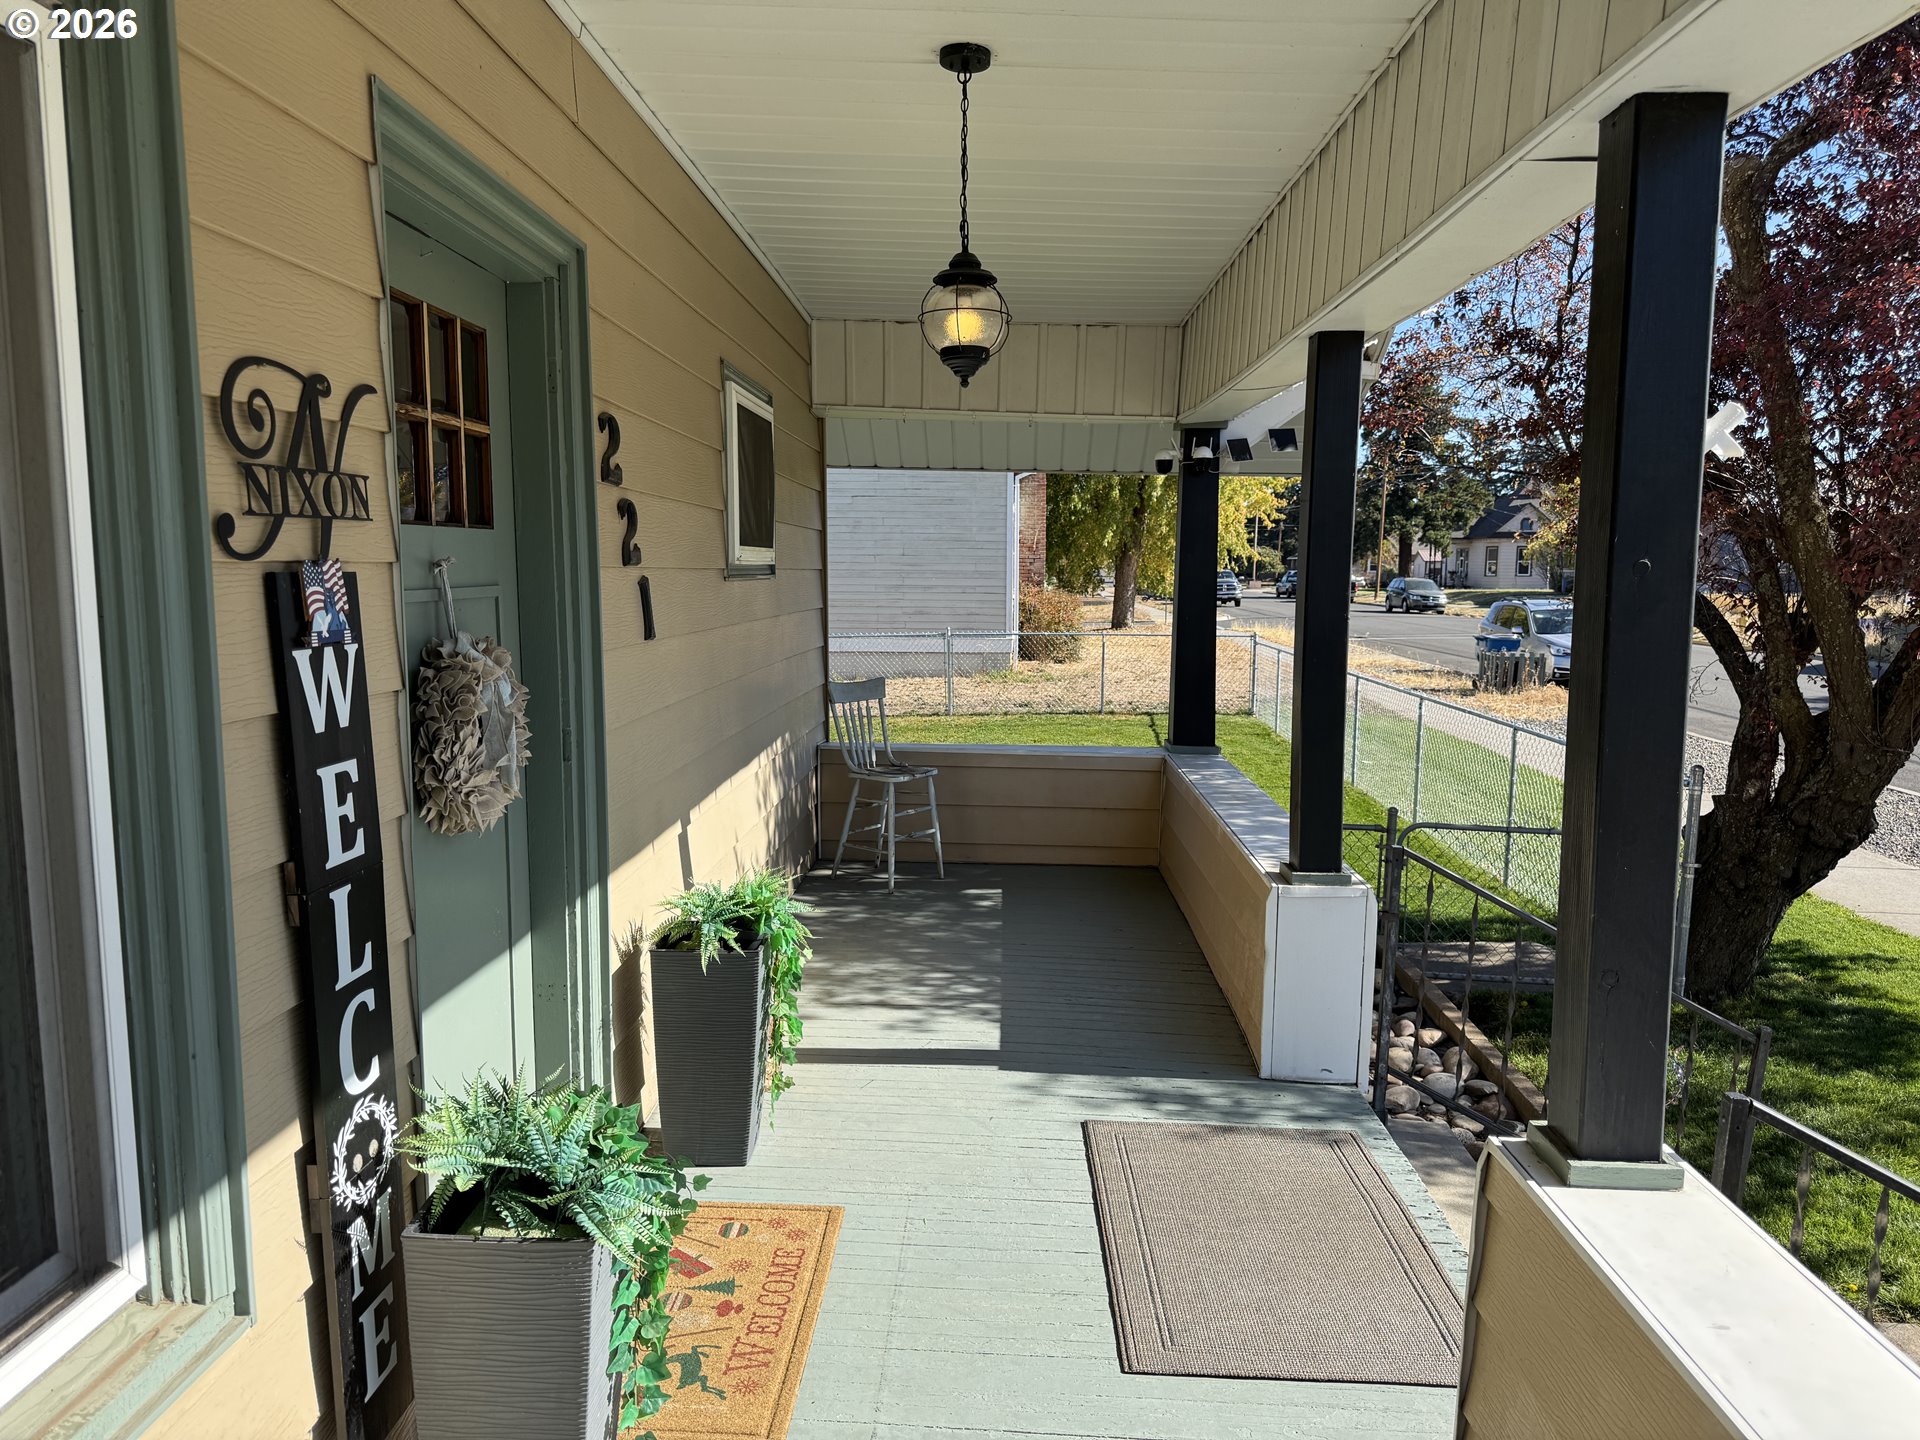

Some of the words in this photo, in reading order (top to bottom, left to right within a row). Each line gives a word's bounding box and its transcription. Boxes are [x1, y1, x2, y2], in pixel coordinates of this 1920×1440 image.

[239, 461, 374, 521] NIXON
[598, 411, 656, 641] 221
[722, 1247, 806, 1376] WELCOME
